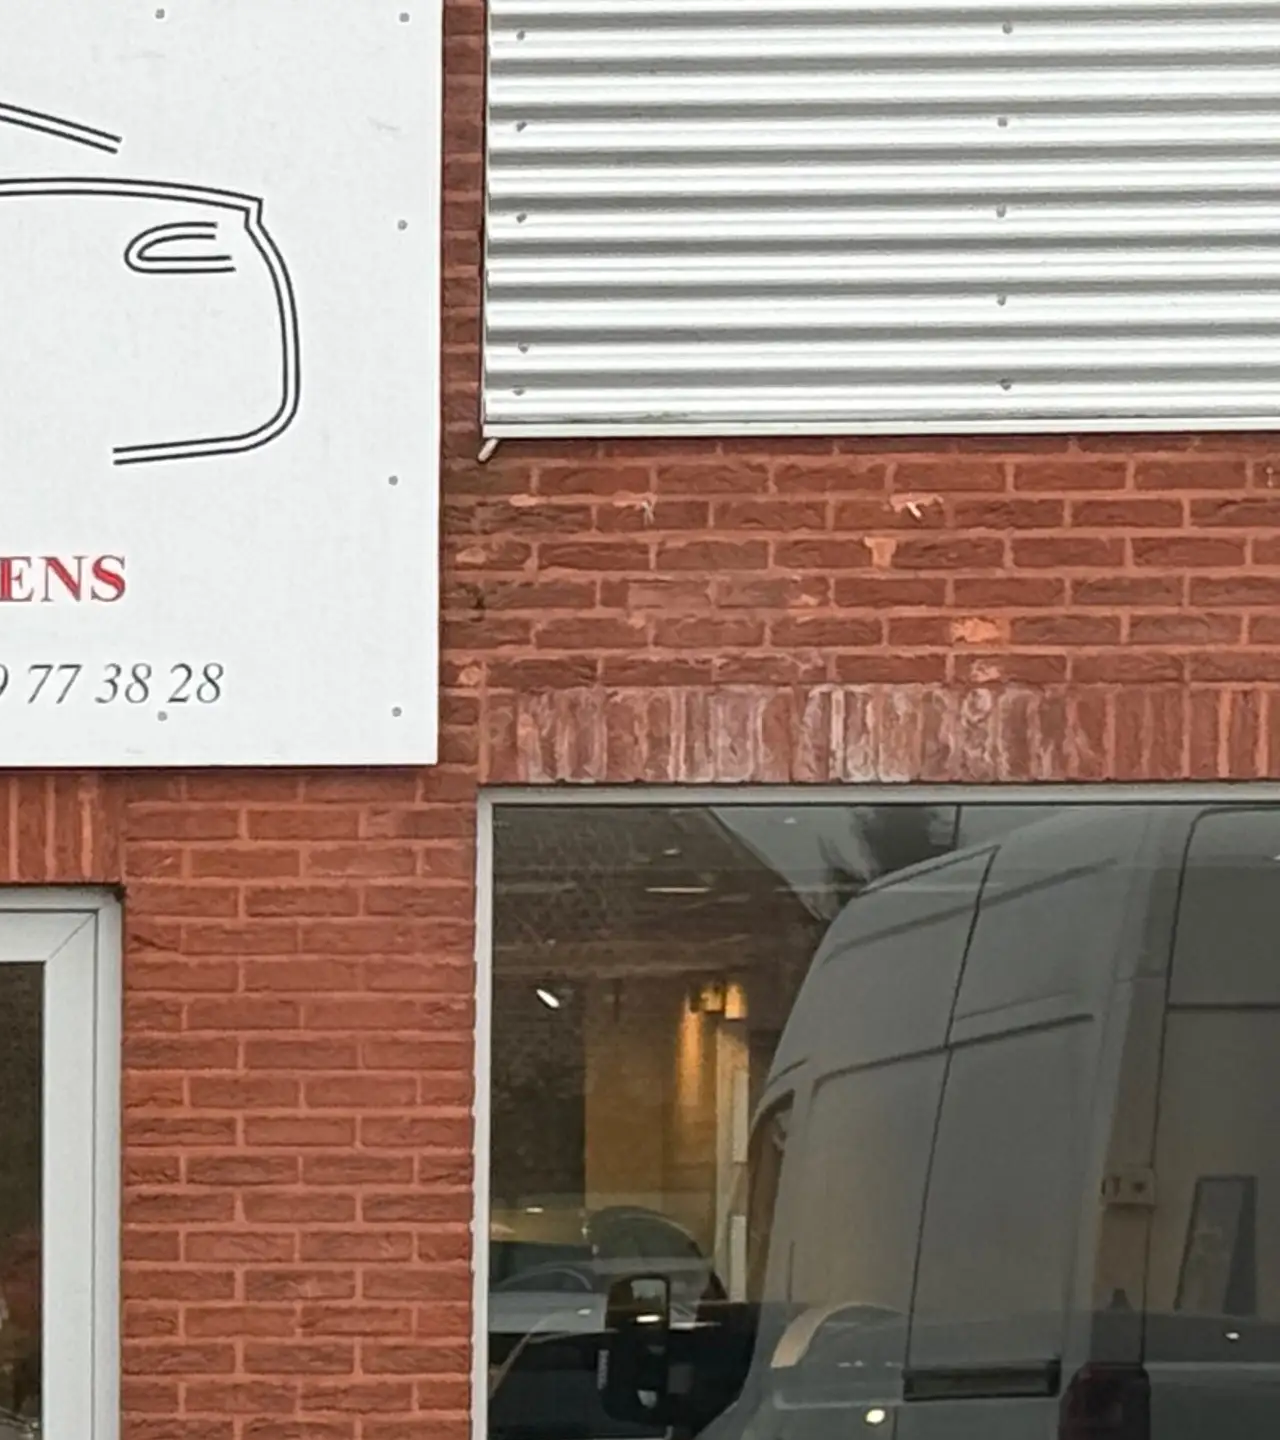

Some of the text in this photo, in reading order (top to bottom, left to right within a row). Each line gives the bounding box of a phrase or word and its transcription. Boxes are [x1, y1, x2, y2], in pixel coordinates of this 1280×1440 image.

[29, 663, 83, 703] 77
[98, 663, 149, 702] 38
[168, 663, 223, 702] 28
